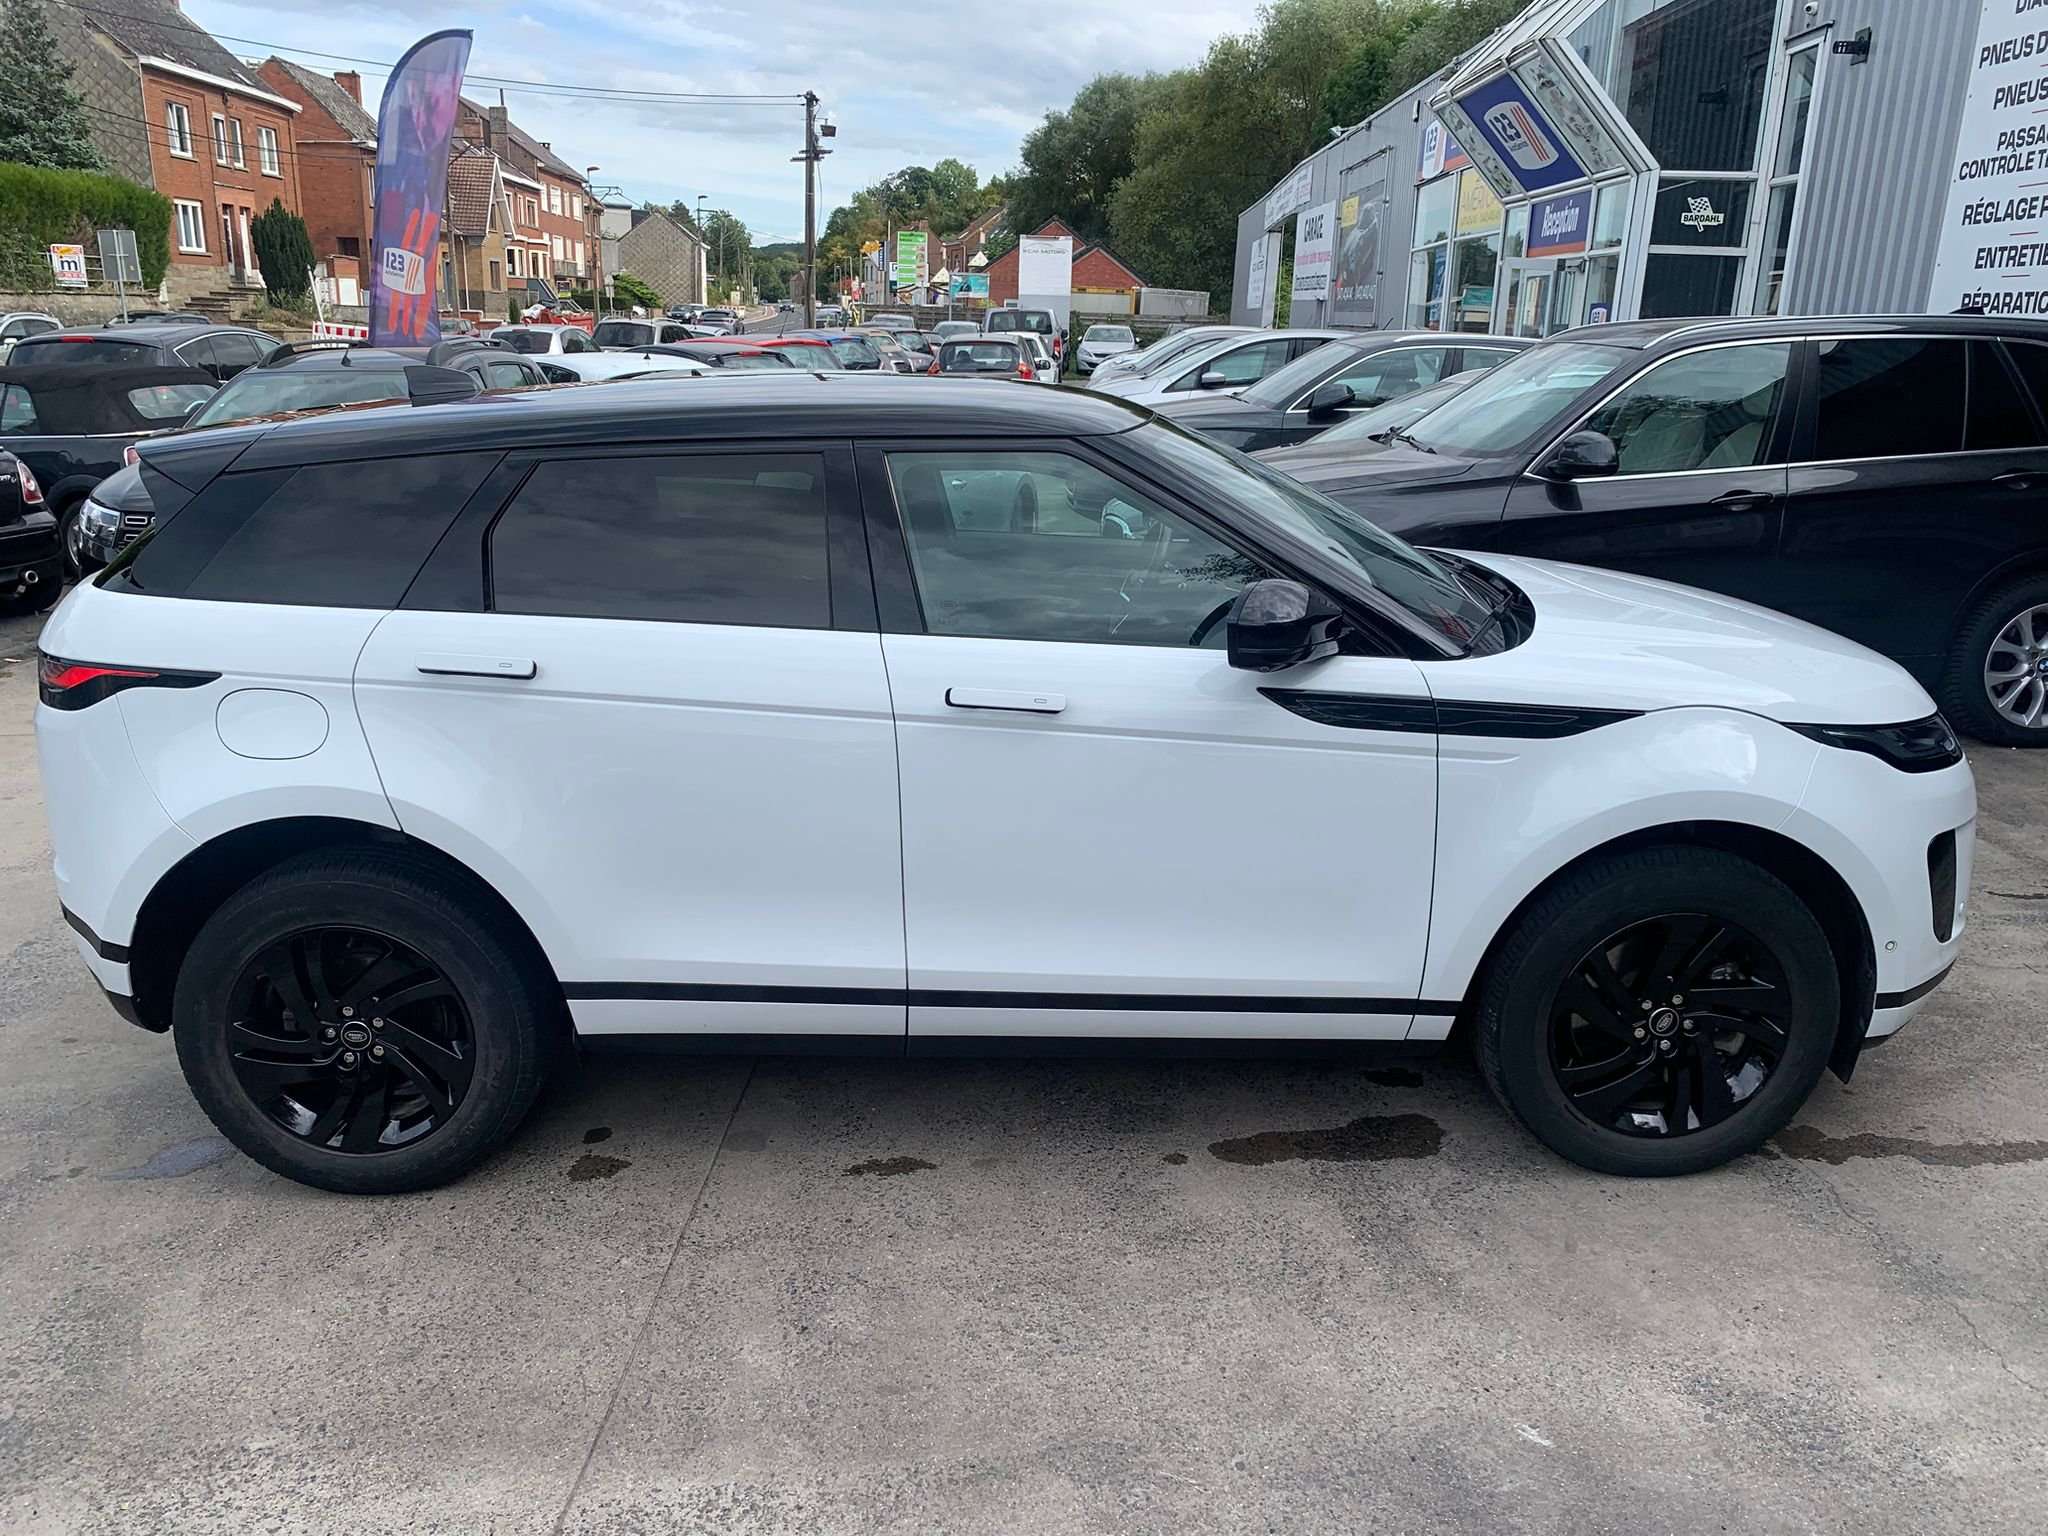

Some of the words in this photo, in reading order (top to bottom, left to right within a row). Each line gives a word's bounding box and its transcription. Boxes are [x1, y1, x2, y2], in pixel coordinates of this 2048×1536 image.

[1979, 34, 2034, 69] PNEUS
[1993, 77, 2048, 110] PNEUS
[1489, 113, 1521, 143] 123
[1997, 124, 2048, 151] PASSA
[1959, 148, 2036, 181] CONTRÔLE
[1541, 200, 1579, 242] Réception
[1683, 214, 1721, 223] BARDAHL
[1962, 196, 2039, 226] RÉGLAGE
[386, 251, 405, 272] 123
